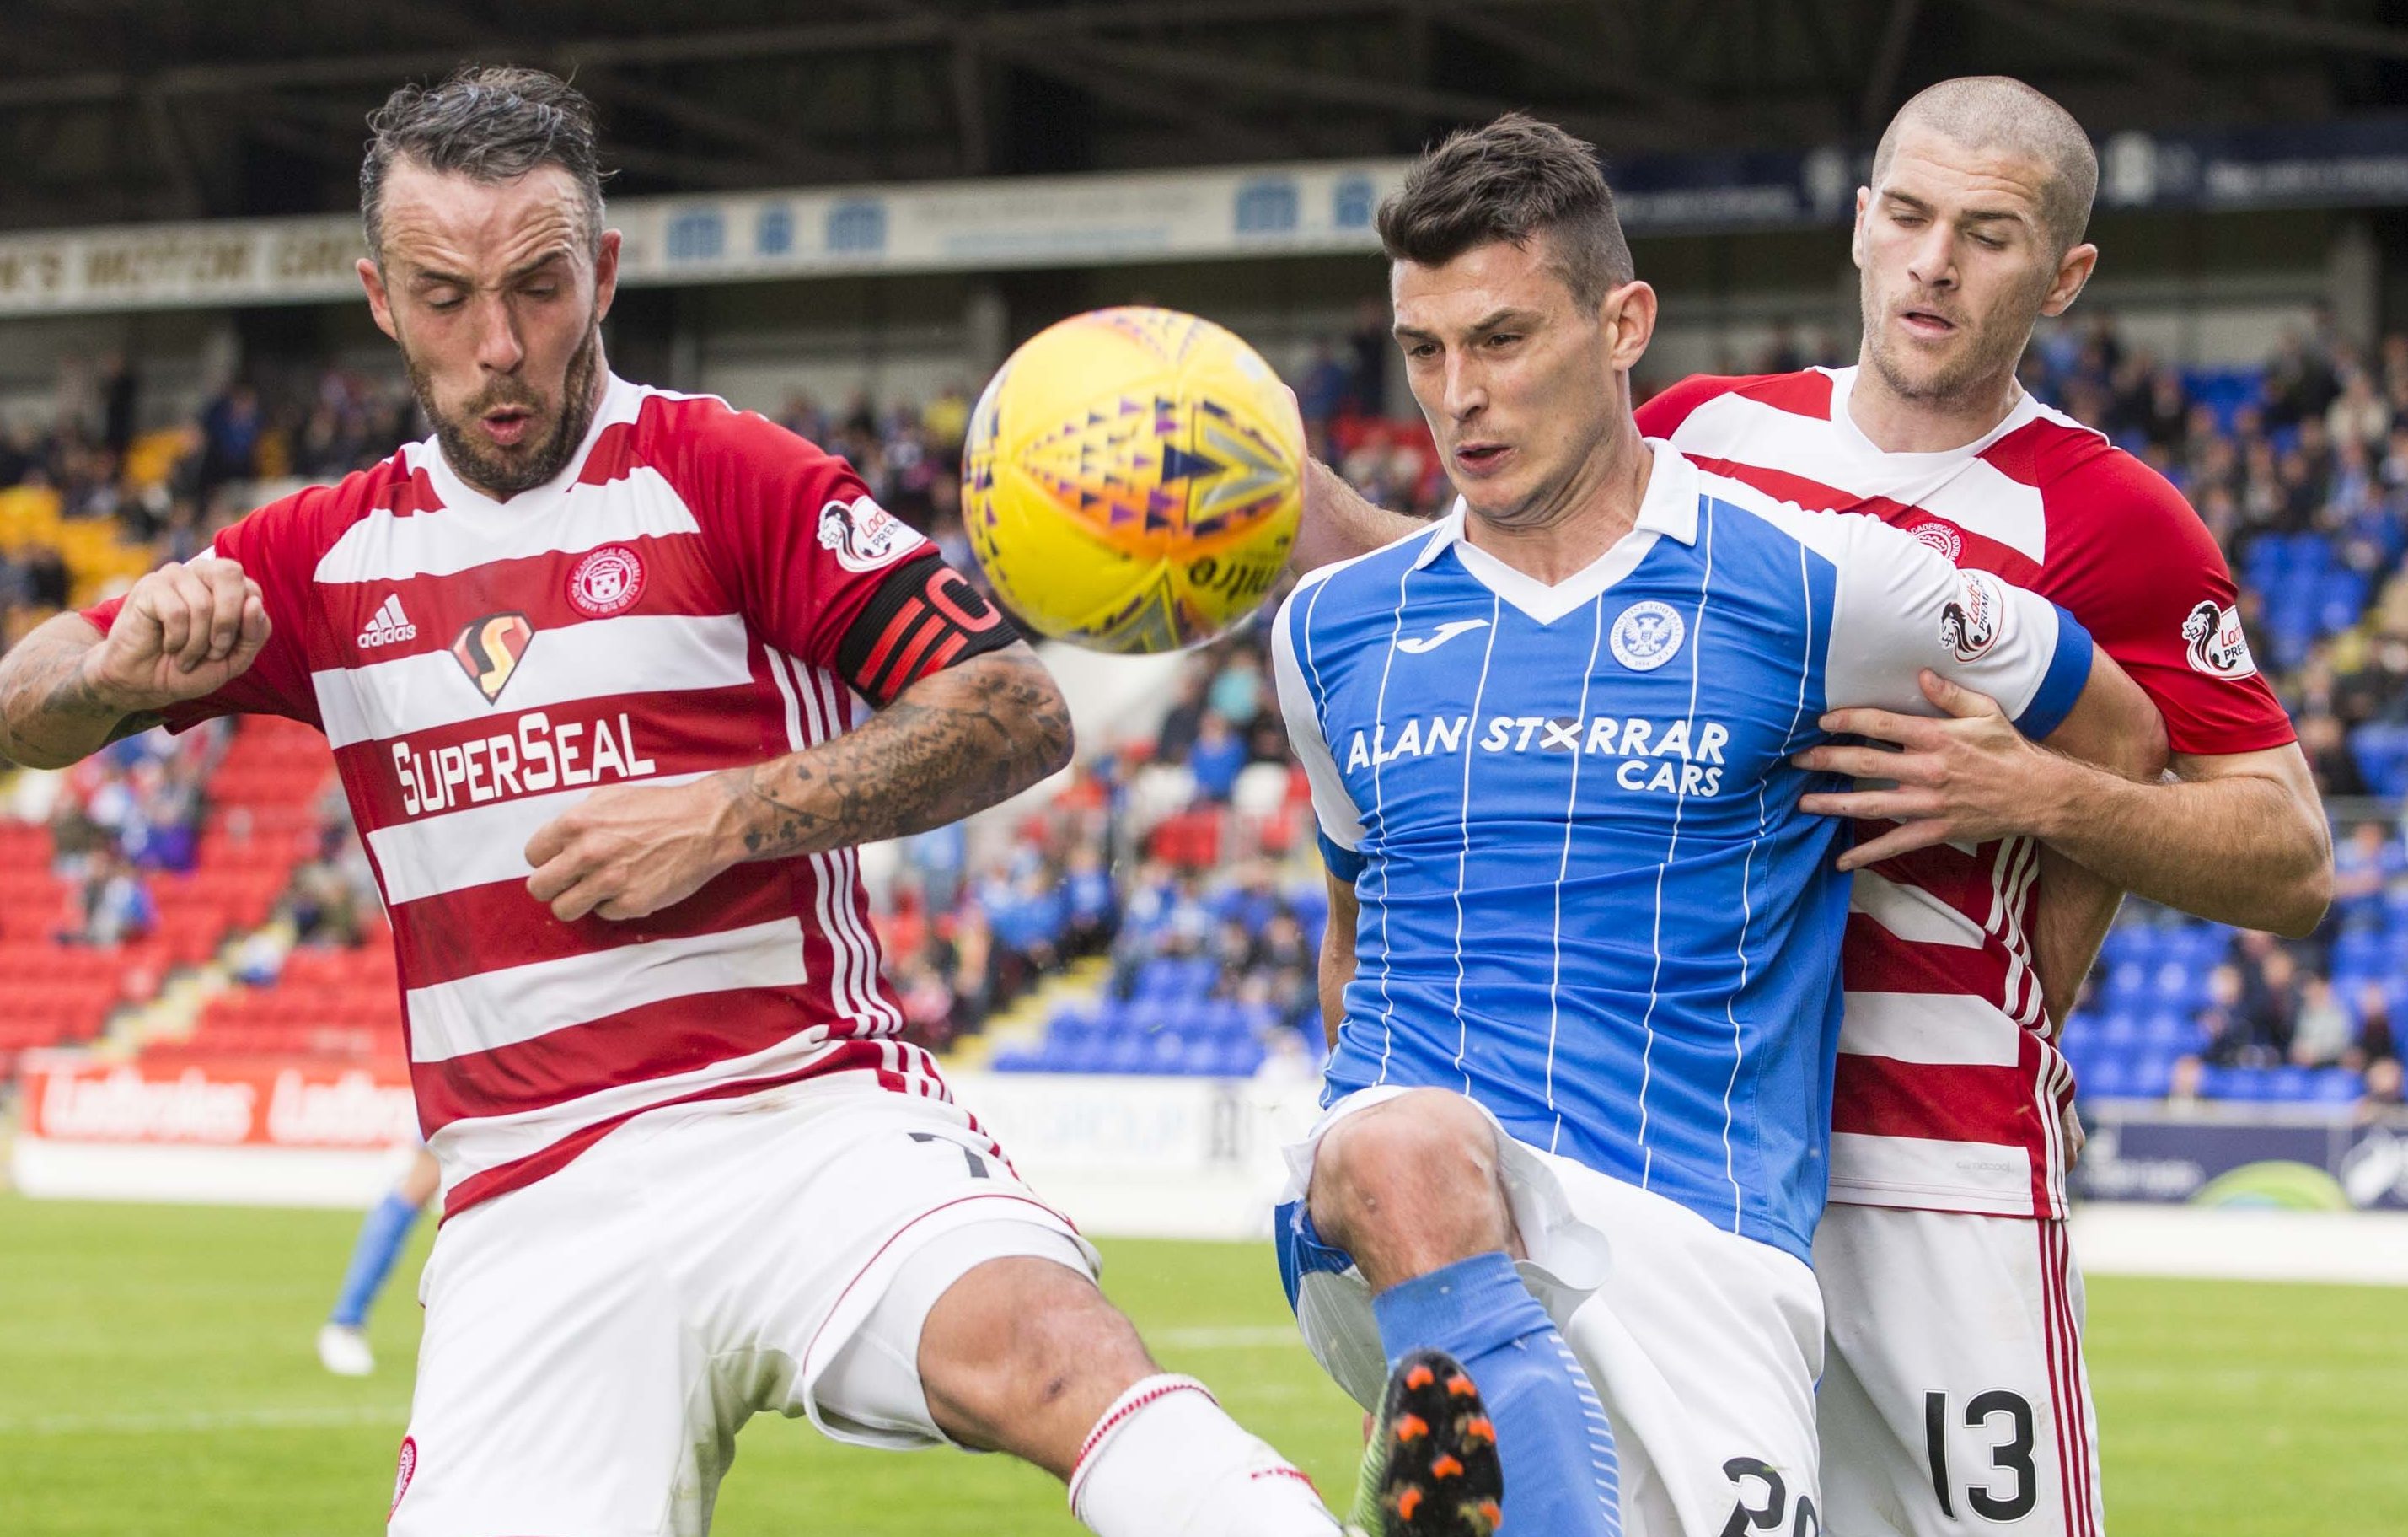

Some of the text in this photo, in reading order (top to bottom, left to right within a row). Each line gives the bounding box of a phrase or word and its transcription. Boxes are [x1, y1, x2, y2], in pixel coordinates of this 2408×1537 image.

[357, 624, 416, 648] adidas
[1347, 716, 1467, 775] ALAN
[1616, 760, 1724, 798] CARS
[1924, 1388, 2038, 1523] 13
